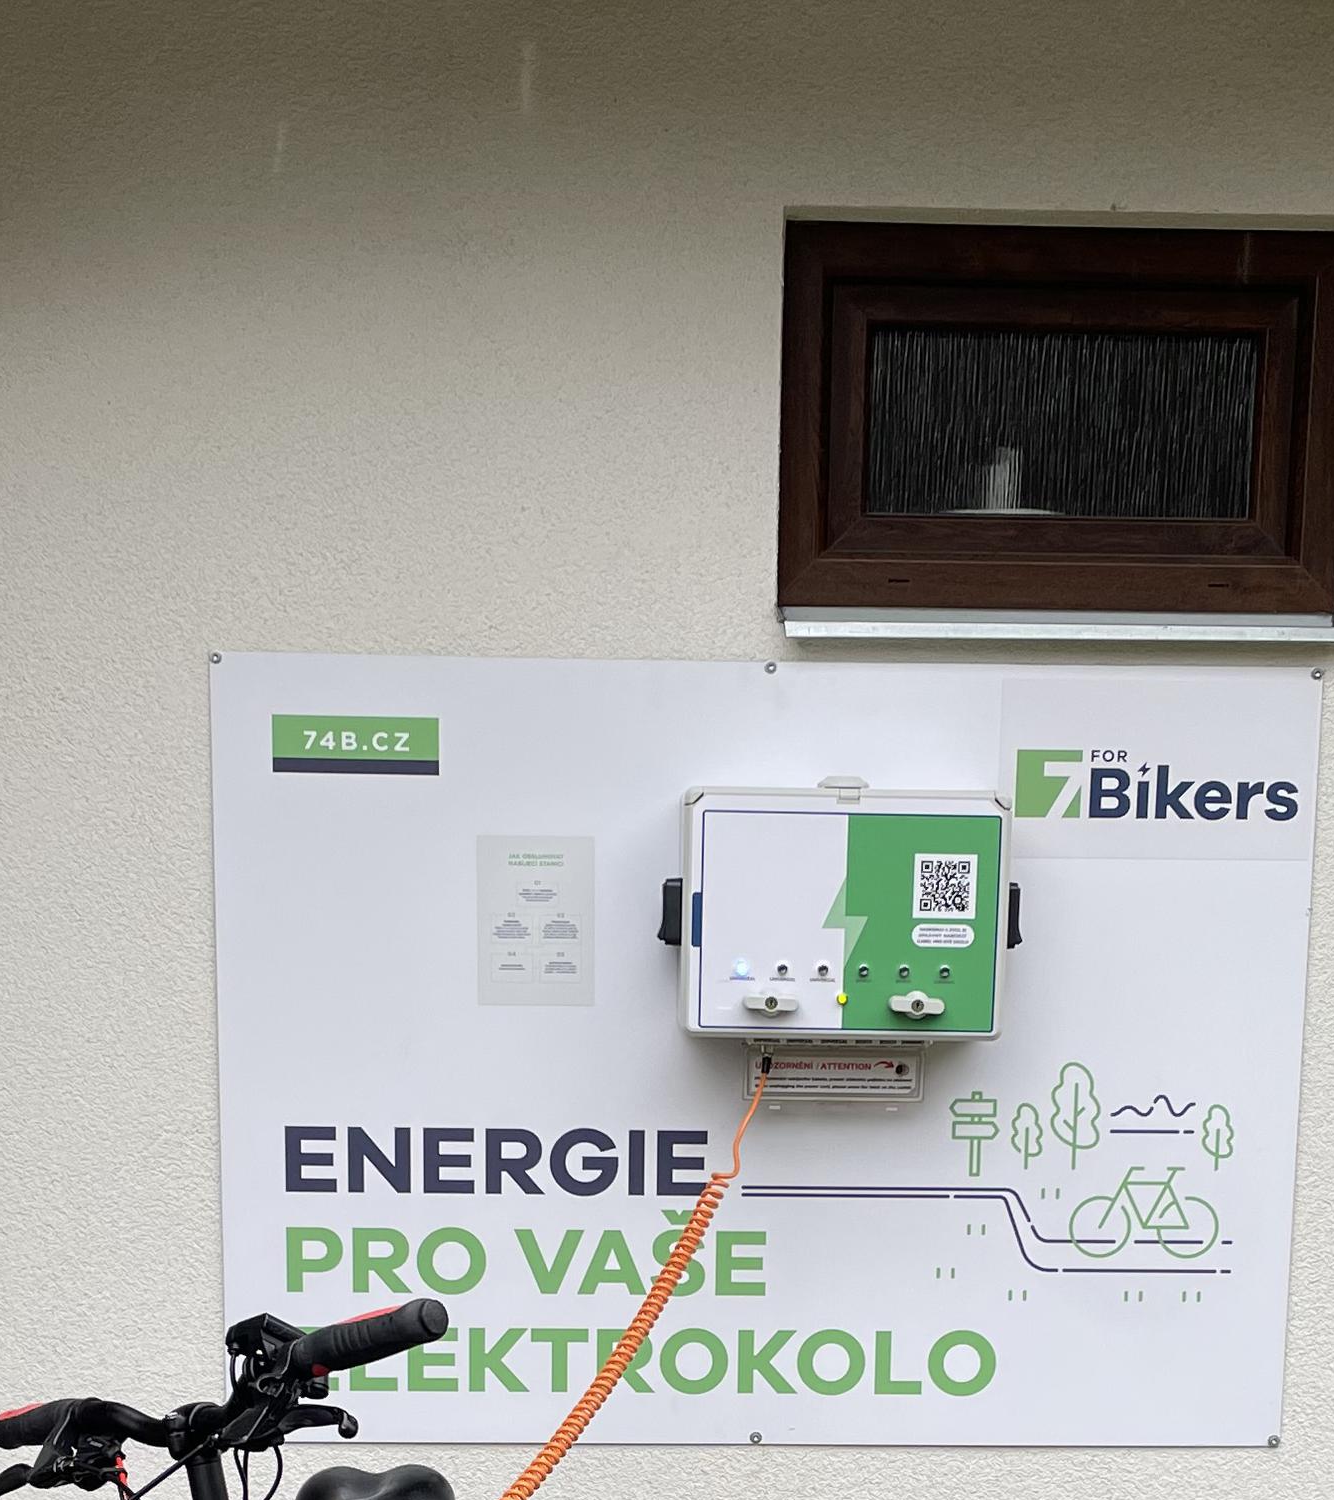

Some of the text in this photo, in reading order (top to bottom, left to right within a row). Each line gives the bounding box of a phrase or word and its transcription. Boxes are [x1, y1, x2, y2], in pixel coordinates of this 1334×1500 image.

[303, 730, 410, 752] 74B.CZ
[1090, 749, 1128, 763] FOR
[1088, 763, 1299, 821] Bikers
[820, 1062, 871, 1071] ATTENTION
[284, 1125, 710, 1197] ENERGIE
[285, 1209, 768, 1298] PRO VAŠE
[299, 1326, 997, 1398] LEKTROKOLO
